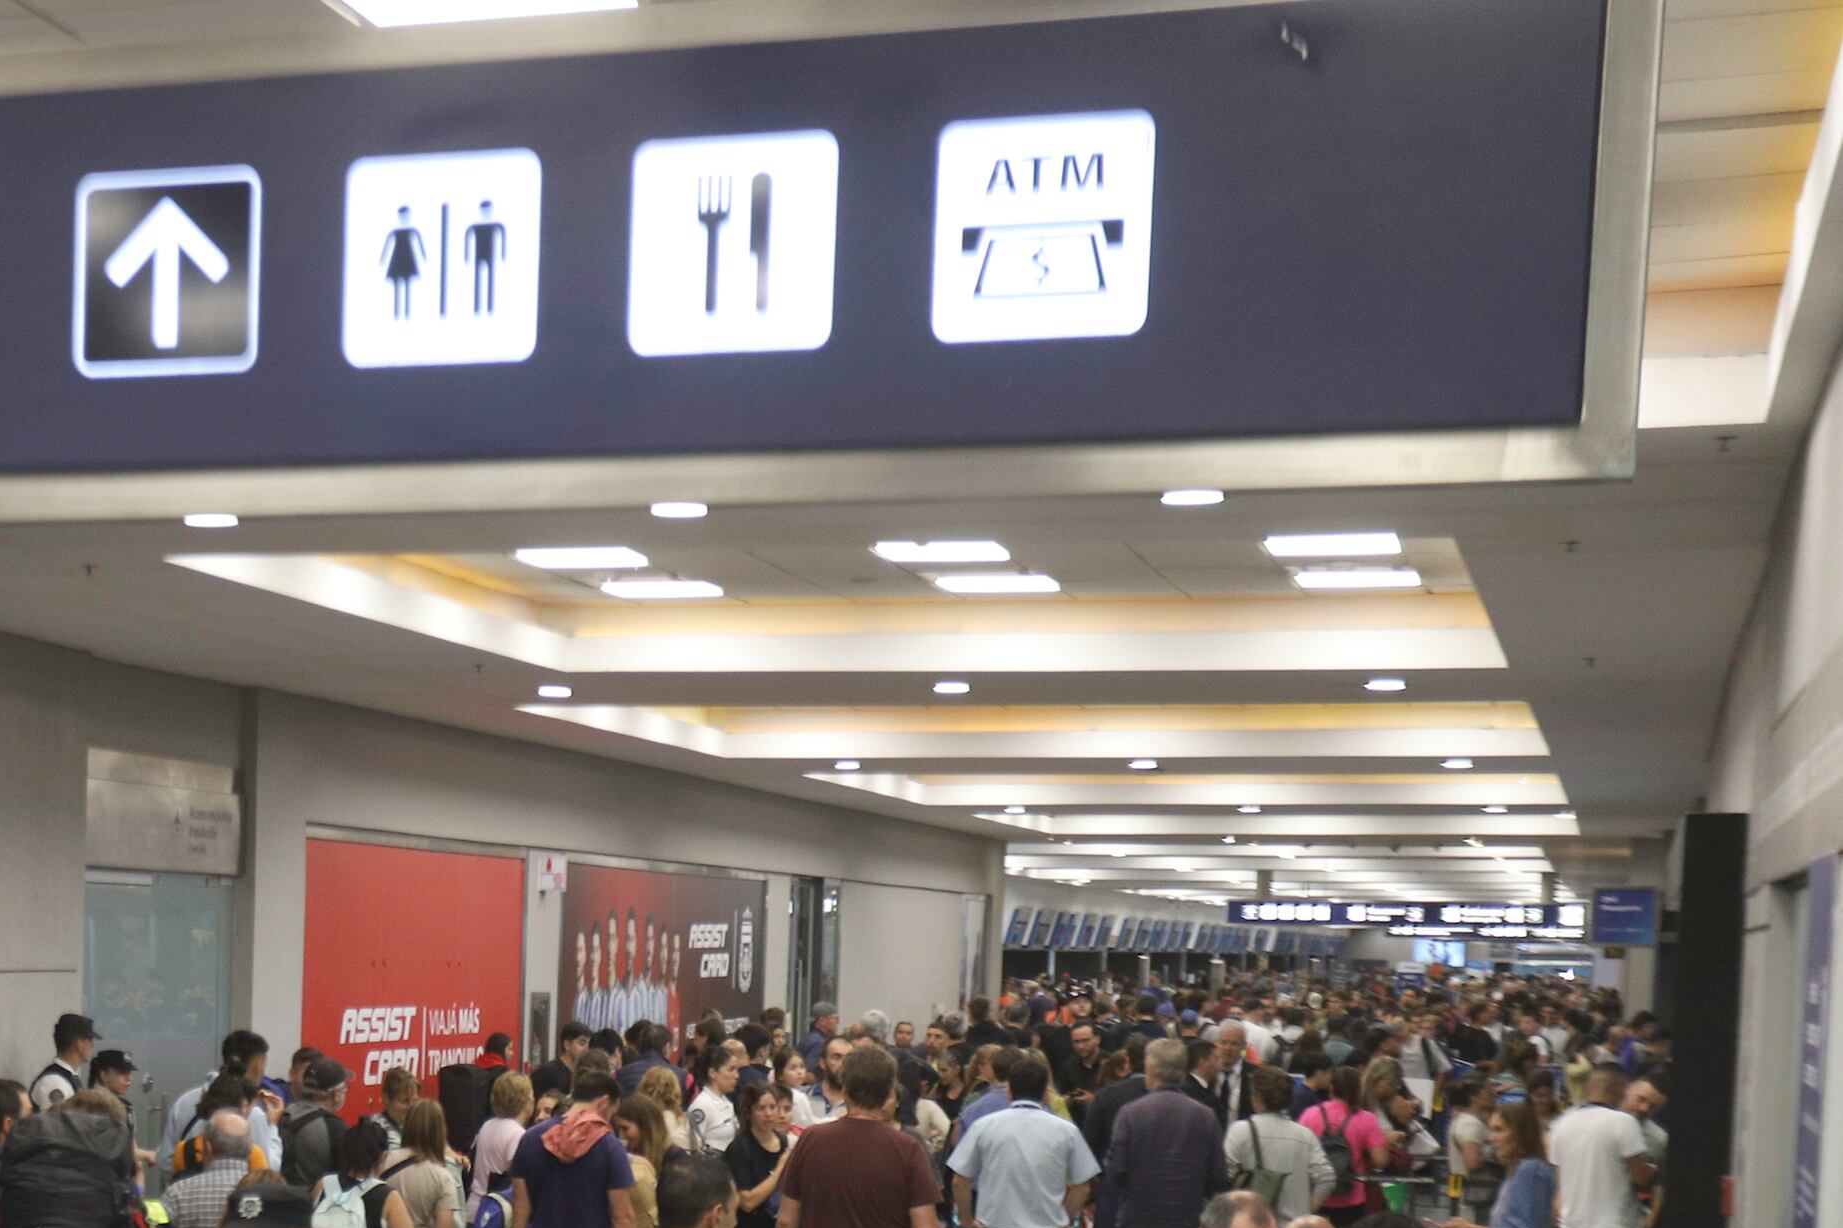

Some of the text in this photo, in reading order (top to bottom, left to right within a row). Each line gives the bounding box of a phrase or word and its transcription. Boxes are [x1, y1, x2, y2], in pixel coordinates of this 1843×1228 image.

[984, 152, 1105, 195] ATM
[688, 923, 729, 949] ASSIST
[699, 952, 730, 979] CARD
[338, 1006, 418, 1045] ASSIST
[428, 1001, 481, 1036] VIAJÁ MÁS
